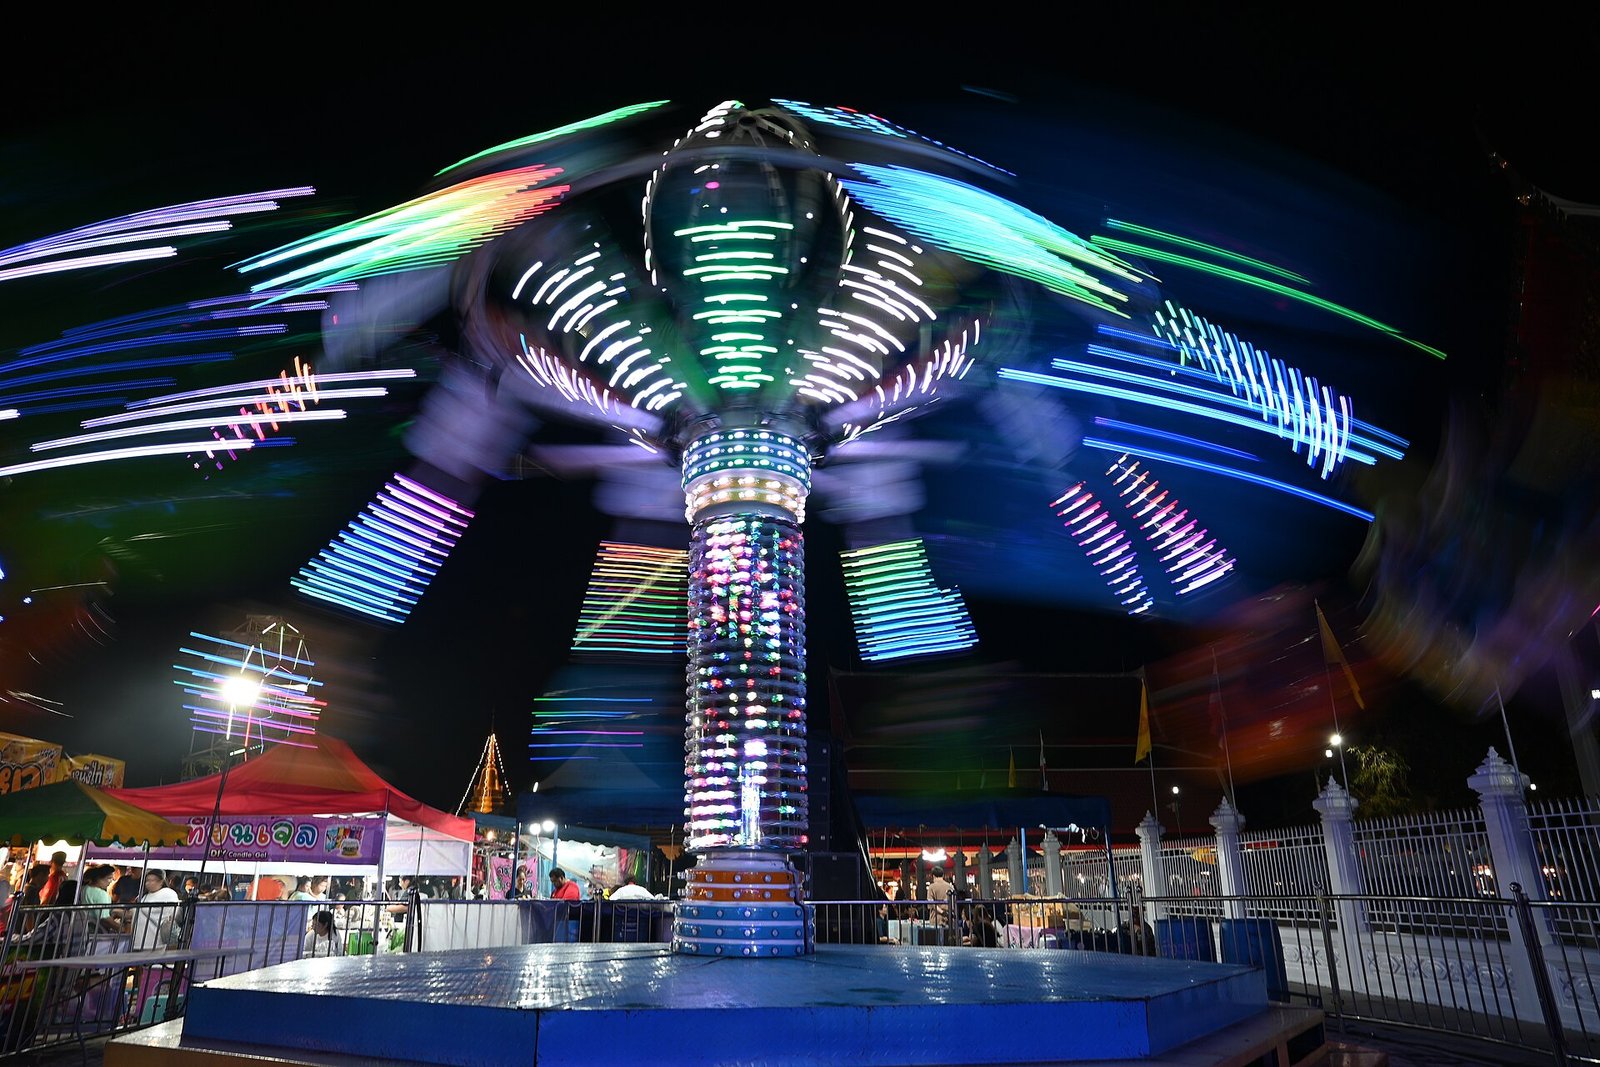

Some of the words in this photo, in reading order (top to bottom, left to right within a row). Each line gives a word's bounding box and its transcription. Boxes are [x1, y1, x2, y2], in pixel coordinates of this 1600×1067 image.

[187, 816, 318, 849] ทียนเจล
[210, 849, 227, 858] DIY
[228, 850, 252, 858] Candle
